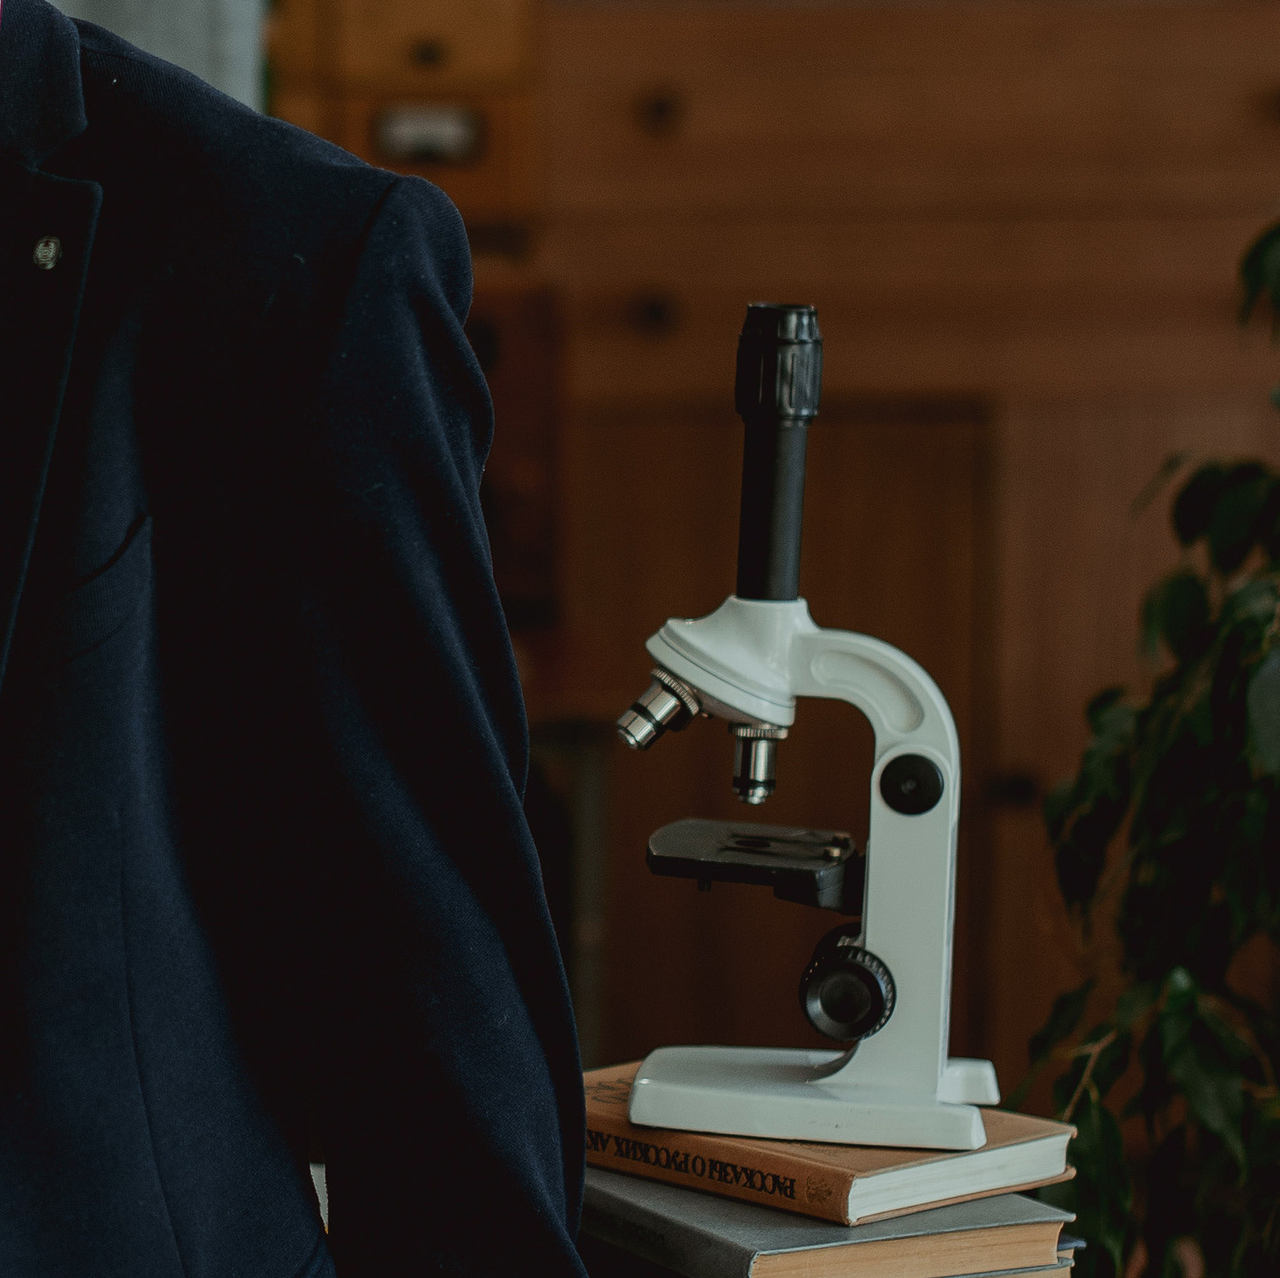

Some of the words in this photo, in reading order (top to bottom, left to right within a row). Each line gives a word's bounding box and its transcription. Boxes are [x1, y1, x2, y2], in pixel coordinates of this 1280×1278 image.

[612, 1136, 690, 1174] РУССКИХ
[691, 1156, 706, 1178] О
[707, 1156, 797, 1200] РАССКАЗЫ
